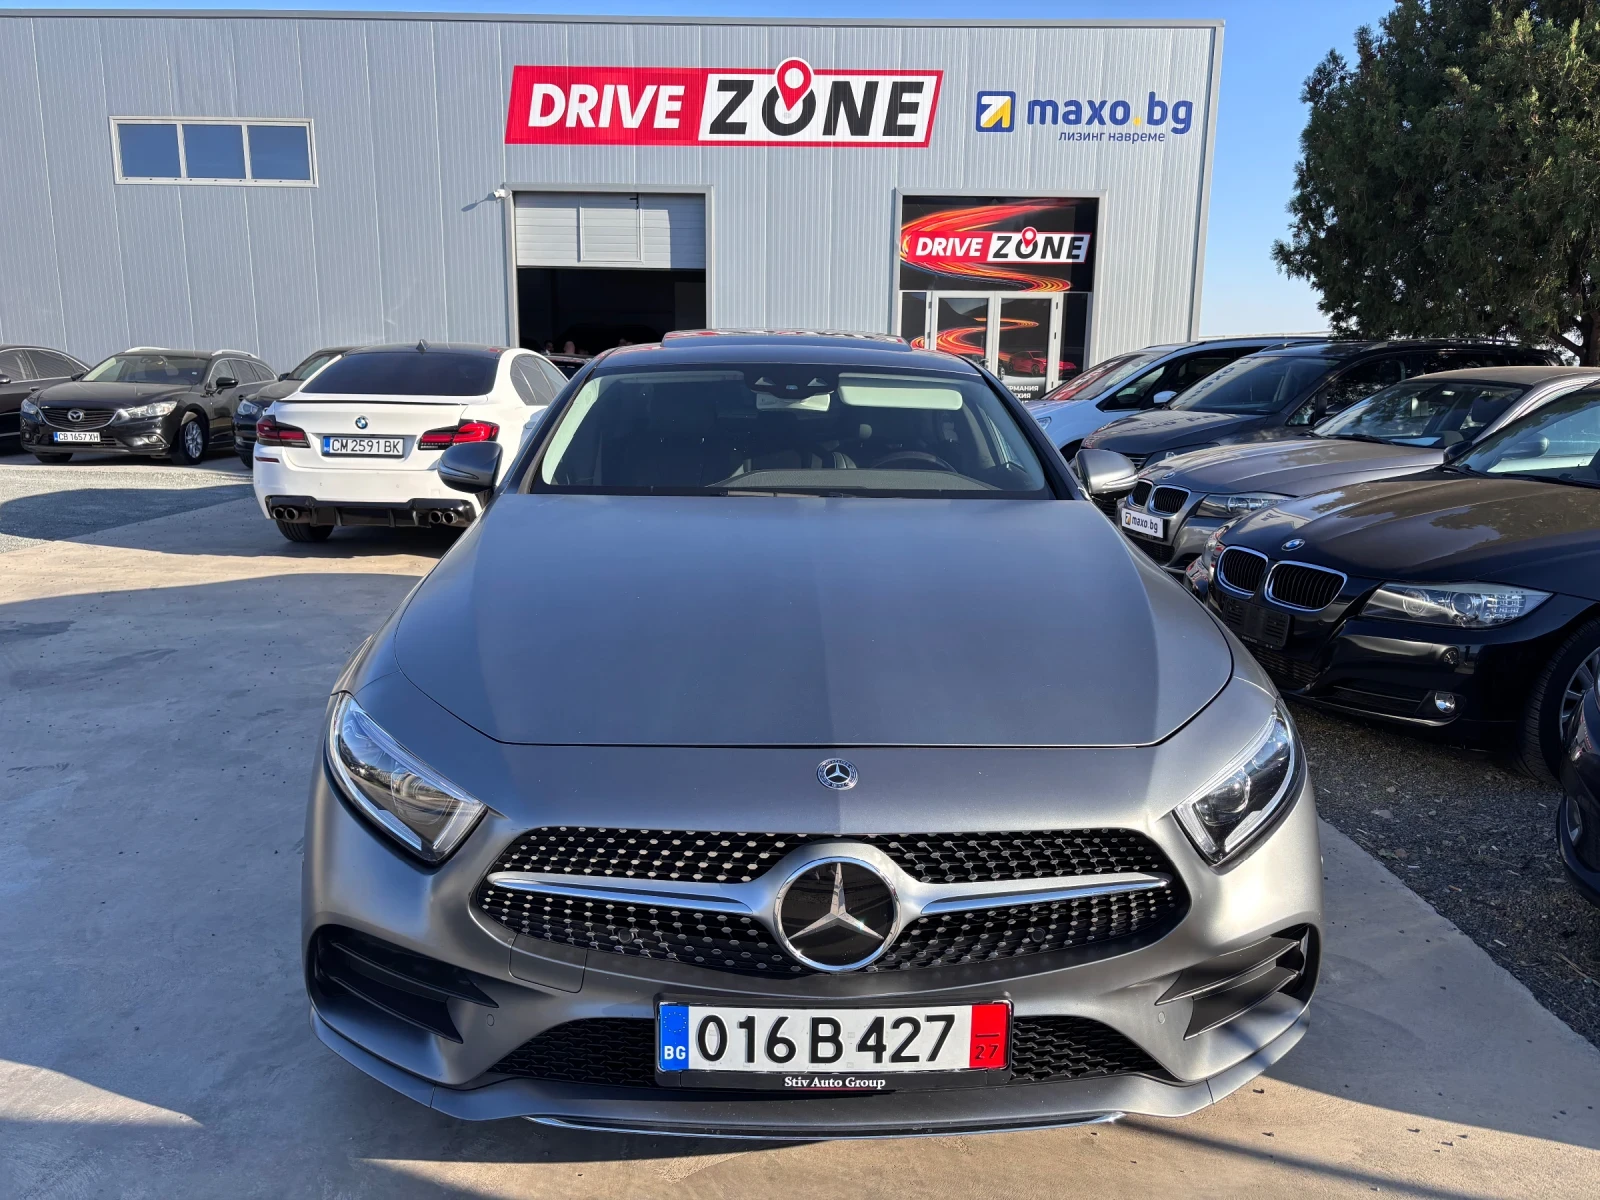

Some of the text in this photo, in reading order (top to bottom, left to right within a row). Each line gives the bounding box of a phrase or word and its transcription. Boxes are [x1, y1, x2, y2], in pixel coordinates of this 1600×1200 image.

[527, 79, 925, 137] DRIVE ZONE
[1027, 91, 1193, 135] maxo.bg
[1059, 131, 1165, 144] лизинг навреме
[915, 235, 1085, 260] DRIVE ZONE
[70, 433, 87, 441] 1657
[331, 438, 349, 452] CM
[350, 440, 380, 453] 2591
[383, 440, 401, 454] BK
[1132, 516, 1158, 534] maxo.bg
[695, 1014, 956, 1064] 016 B 427
[663, 1045, 687, 1060] BG
[974, 1043, 1000, 1061] 27
[784, 1076, 886, 1090] Stiv Auto Group
